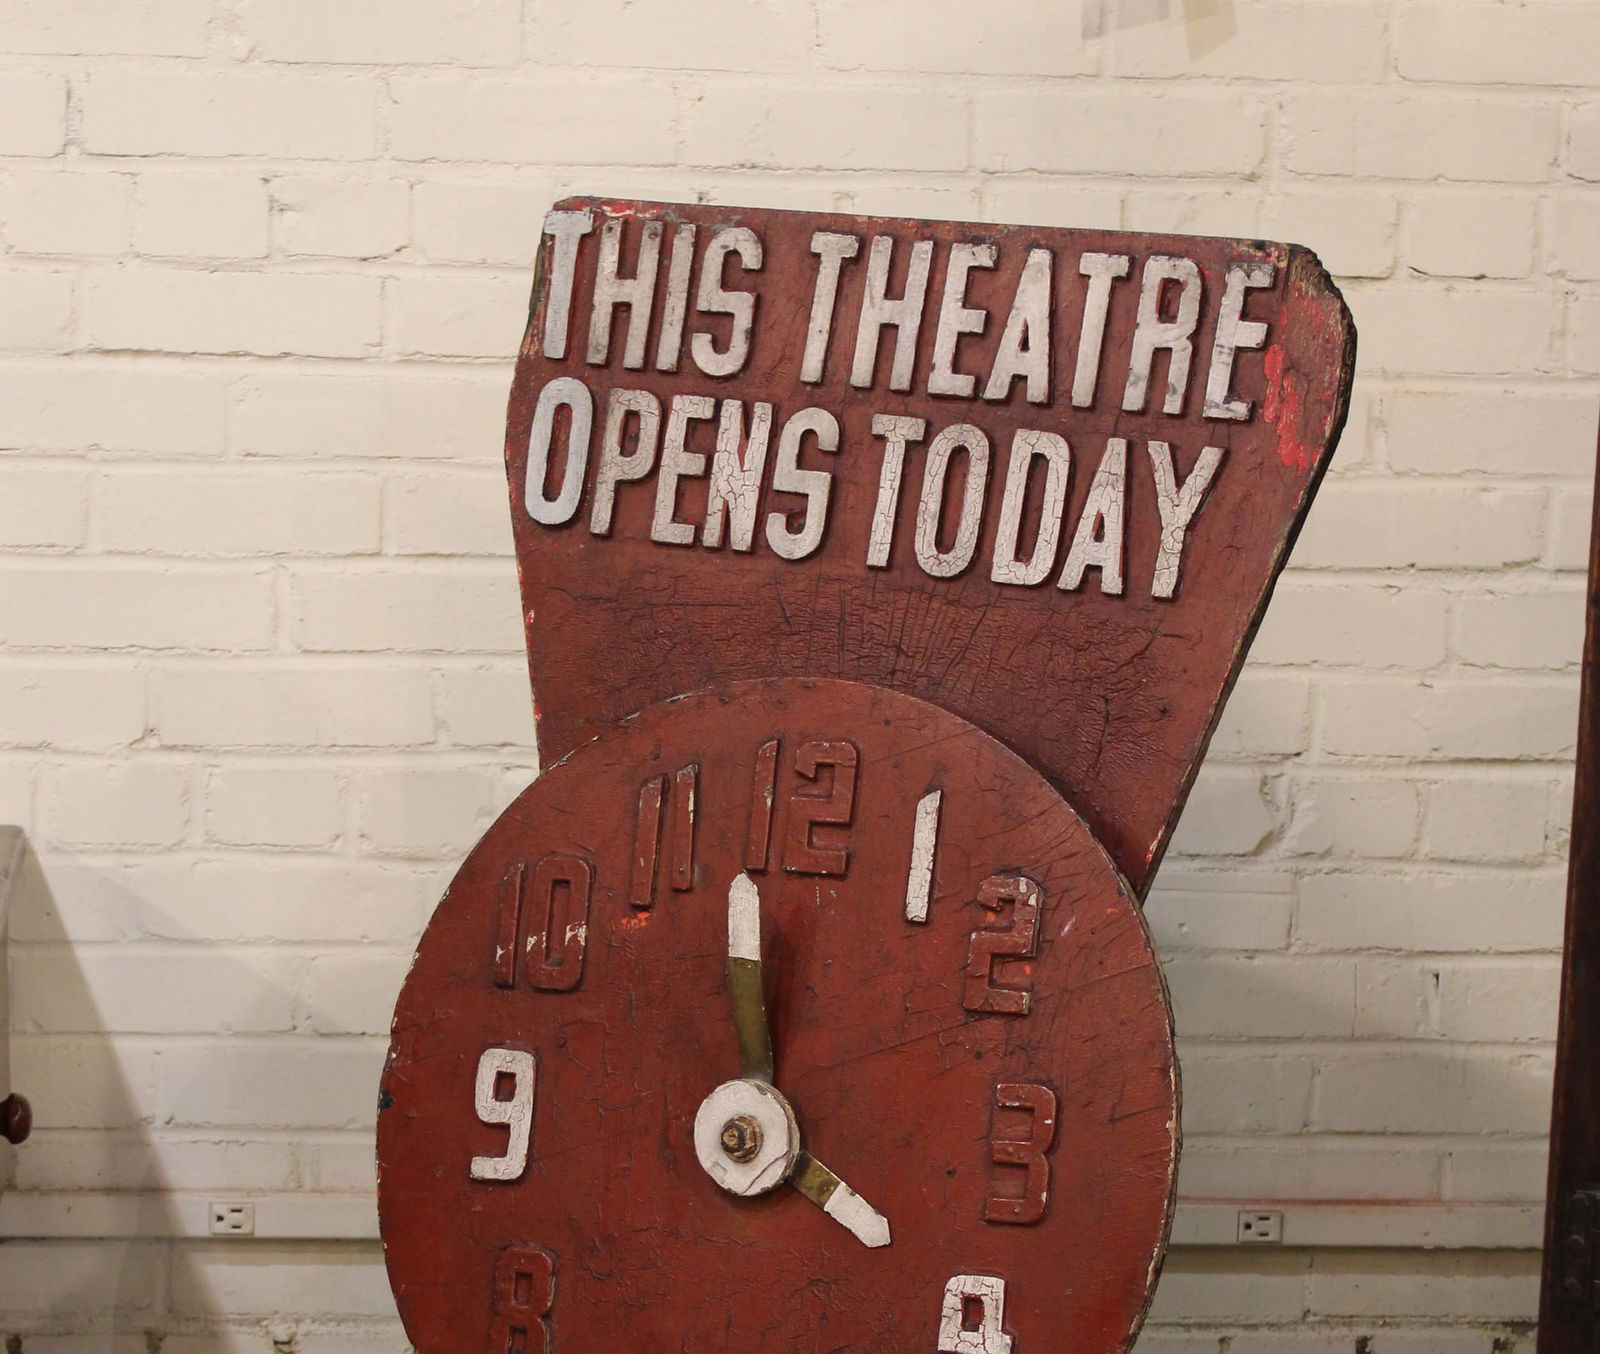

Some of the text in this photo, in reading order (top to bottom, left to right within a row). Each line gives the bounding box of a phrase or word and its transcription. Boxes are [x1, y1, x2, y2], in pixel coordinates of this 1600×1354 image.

[541, 207, 1275, 421] THIS THEATRE
[523, 376, 1227, 600] OPENS TODAY
[630, 763, 700, 908] 11
[743, 738, 860, 876] 12
[904, 788, 942, 923] 1
[493, 854, 594, 993] 10
[963, 874, 1044, 1016] 2
[470, 1048, 536, 1183] 9
[984, 1082, 1060, 1225] 3
